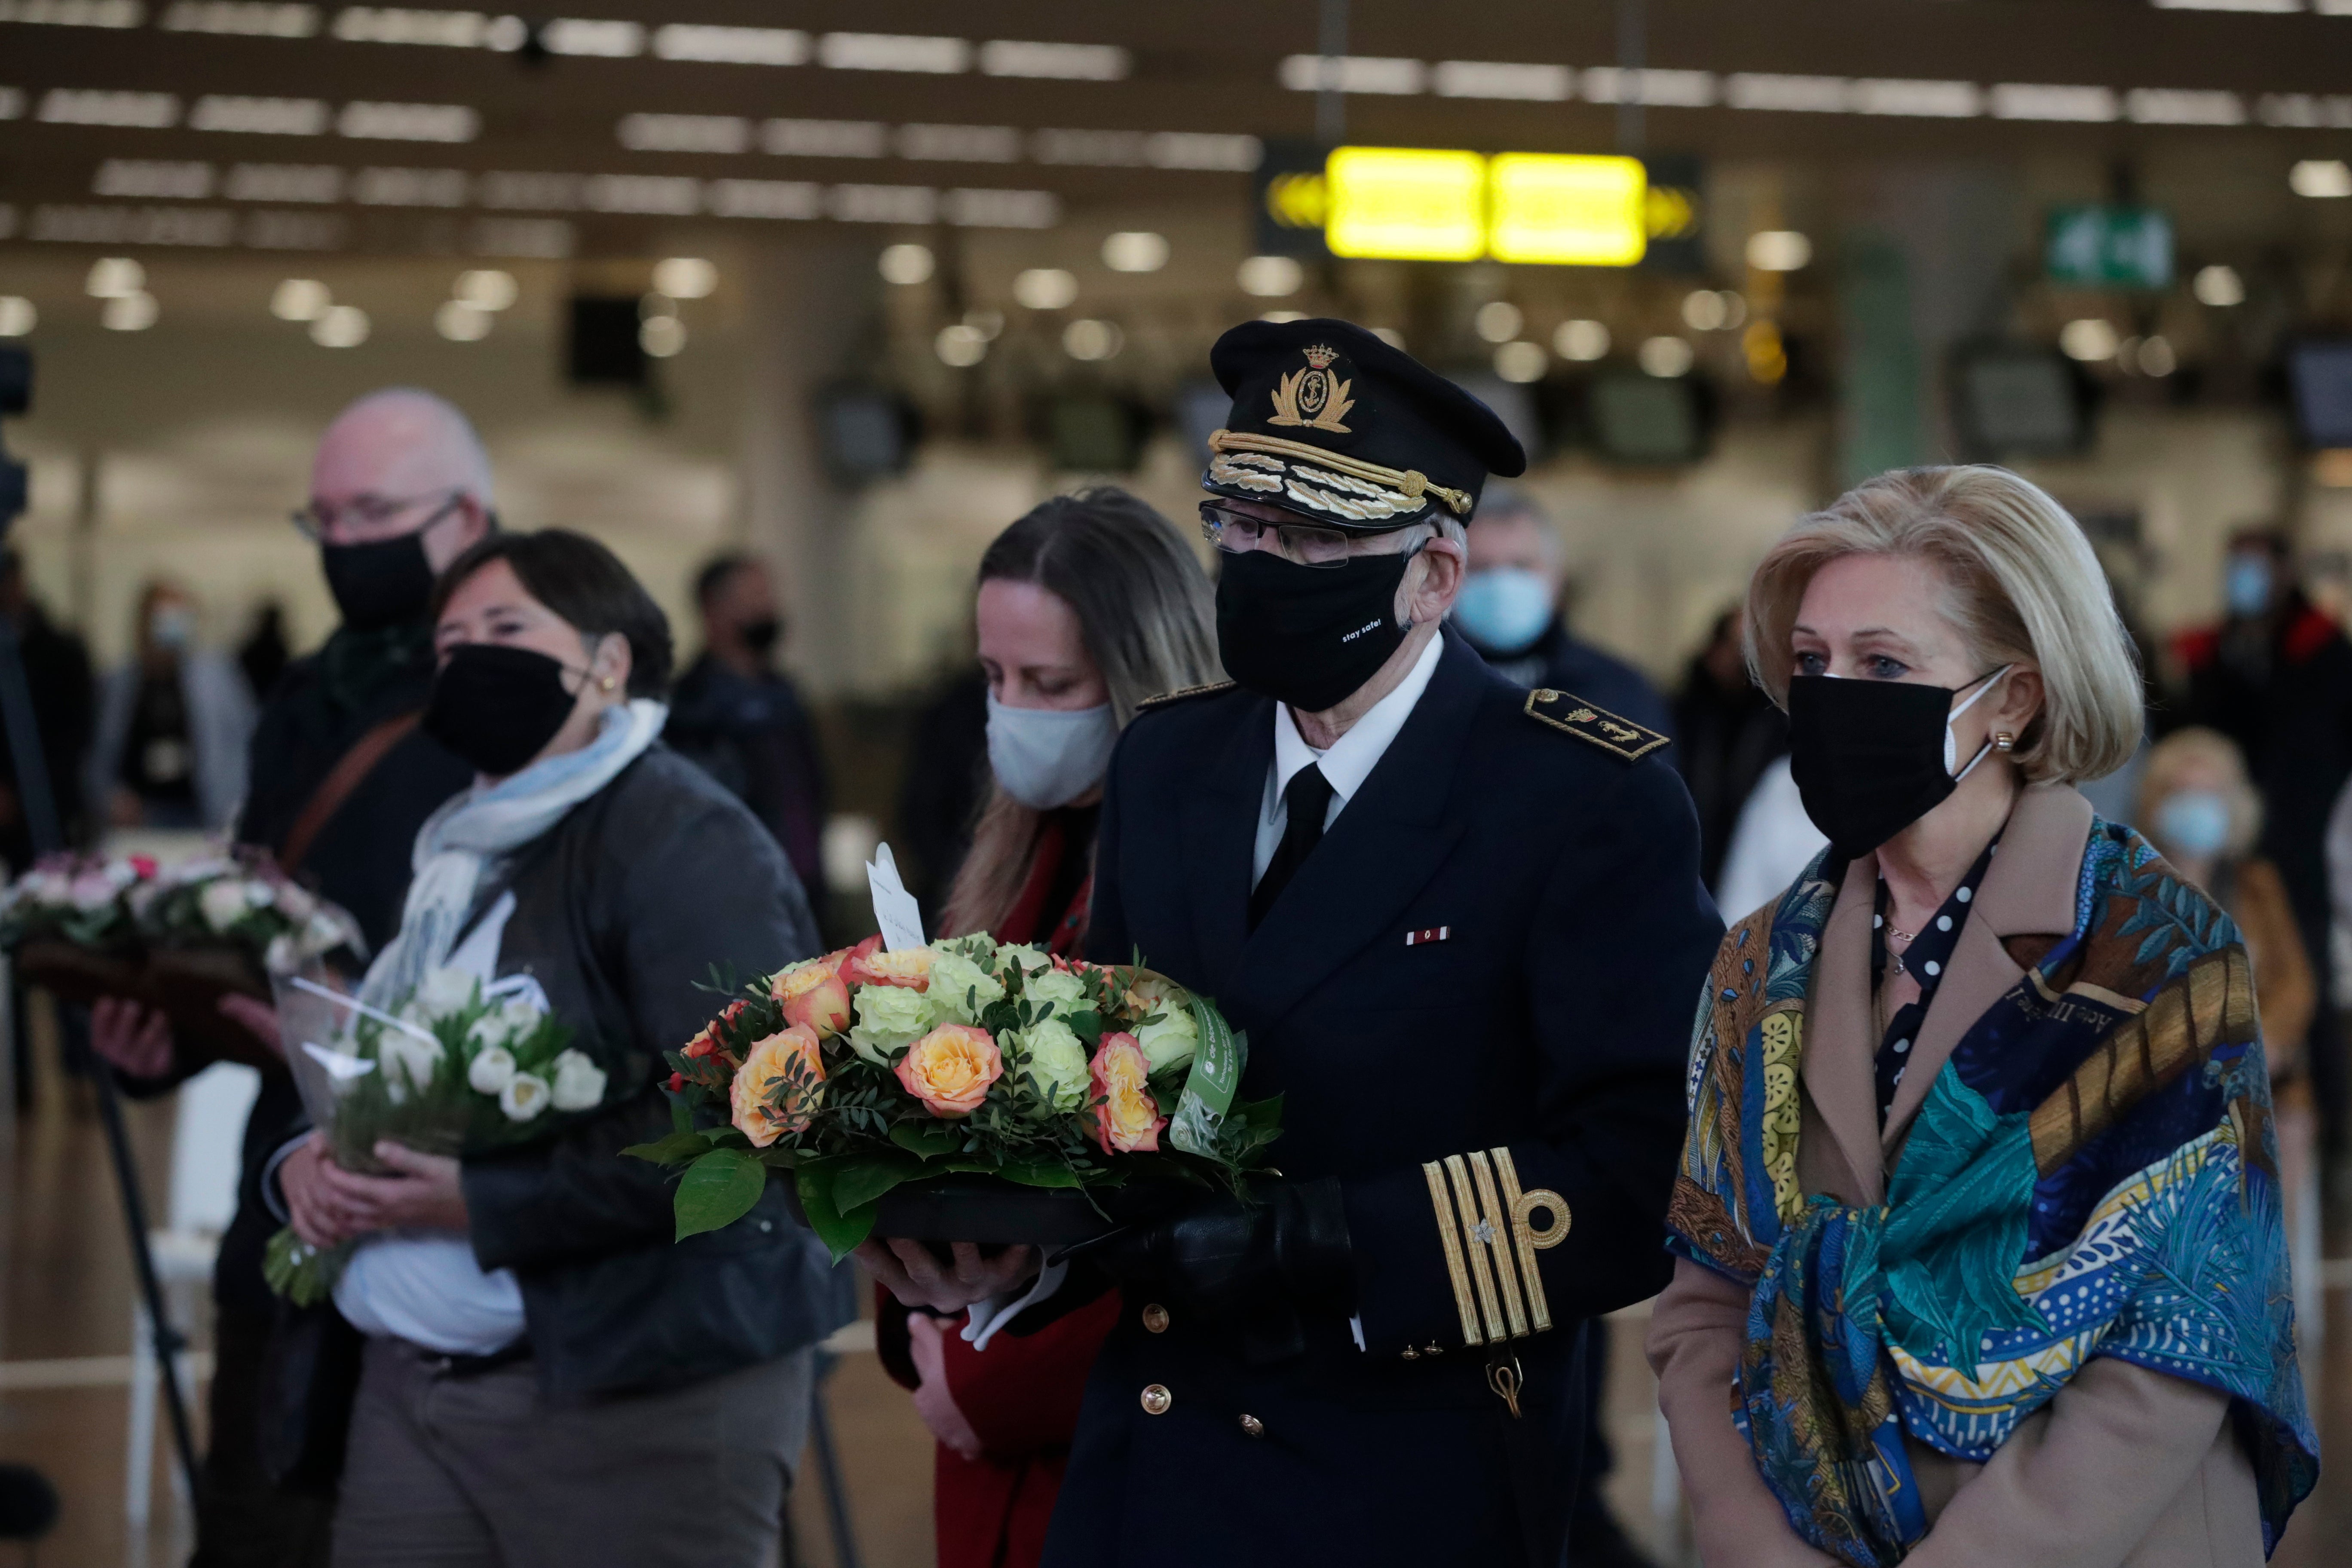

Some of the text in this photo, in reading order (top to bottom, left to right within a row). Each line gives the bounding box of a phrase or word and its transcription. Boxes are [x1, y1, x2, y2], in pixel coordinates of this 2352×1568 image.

[1342, 619, 1381, 643] stay safe!
[1209, 1044, 1216, 1059] de
